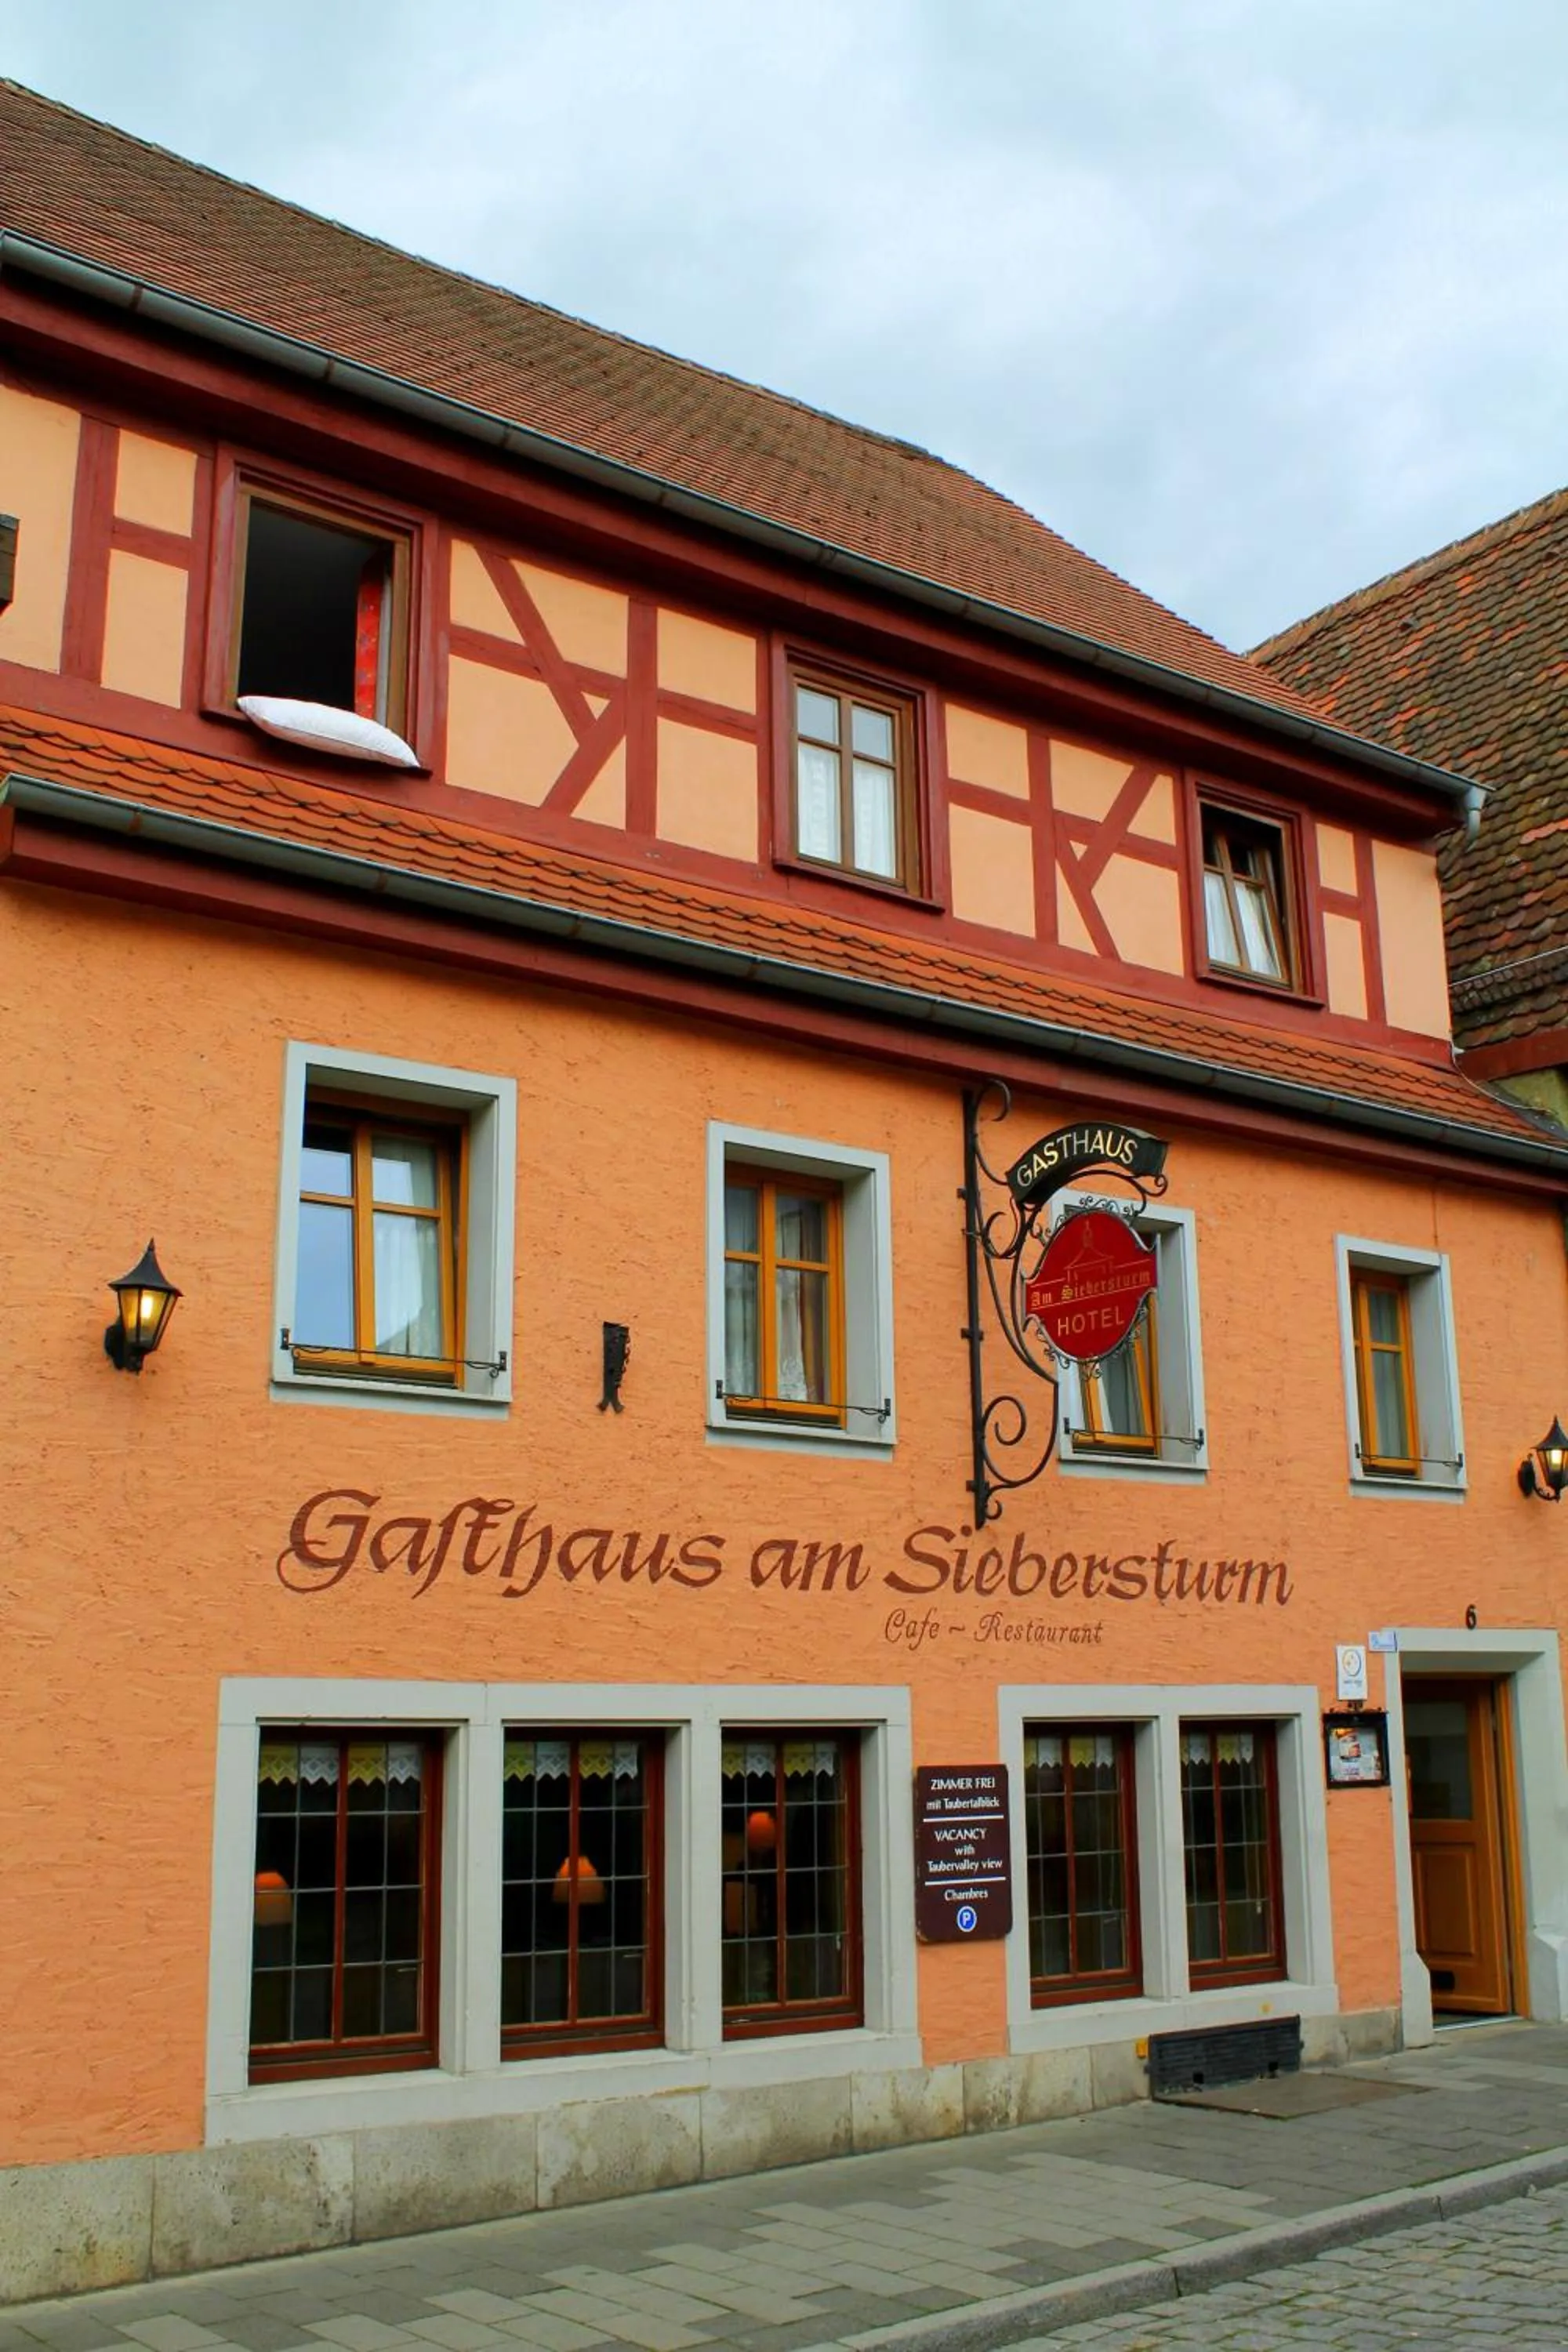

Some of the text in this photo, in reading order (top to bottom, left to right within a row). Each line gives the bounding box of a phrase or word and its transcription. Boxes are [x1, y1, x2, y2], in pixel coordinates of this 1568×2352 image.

[1017, 1129, 1138, 1187] GASTHAUS
[1031, 1290, 1052, 1307] Am
[1058, 1305, 1125, 1336] HOTEL
[750, 1537, 871, 1592] am
[882, 1525, 1294, 1606] Siebersturm
[1466, 1604, 1476, 1631] 6
[884, 1607, 941, 1651] Cafe
[972, 1610, 1104, 1646] Restaurant
[931, 1777, 995, 1791] ZIMMER FREI
[927, 1799, 942, 1810] mit
[935, 1828, 987, 1842] VACANCY
[955, 1844, 975, 1856] with
[927, 1857, 1003, 1875] Taubervalley view
[945, 1888, 989, 1901] Chambres
